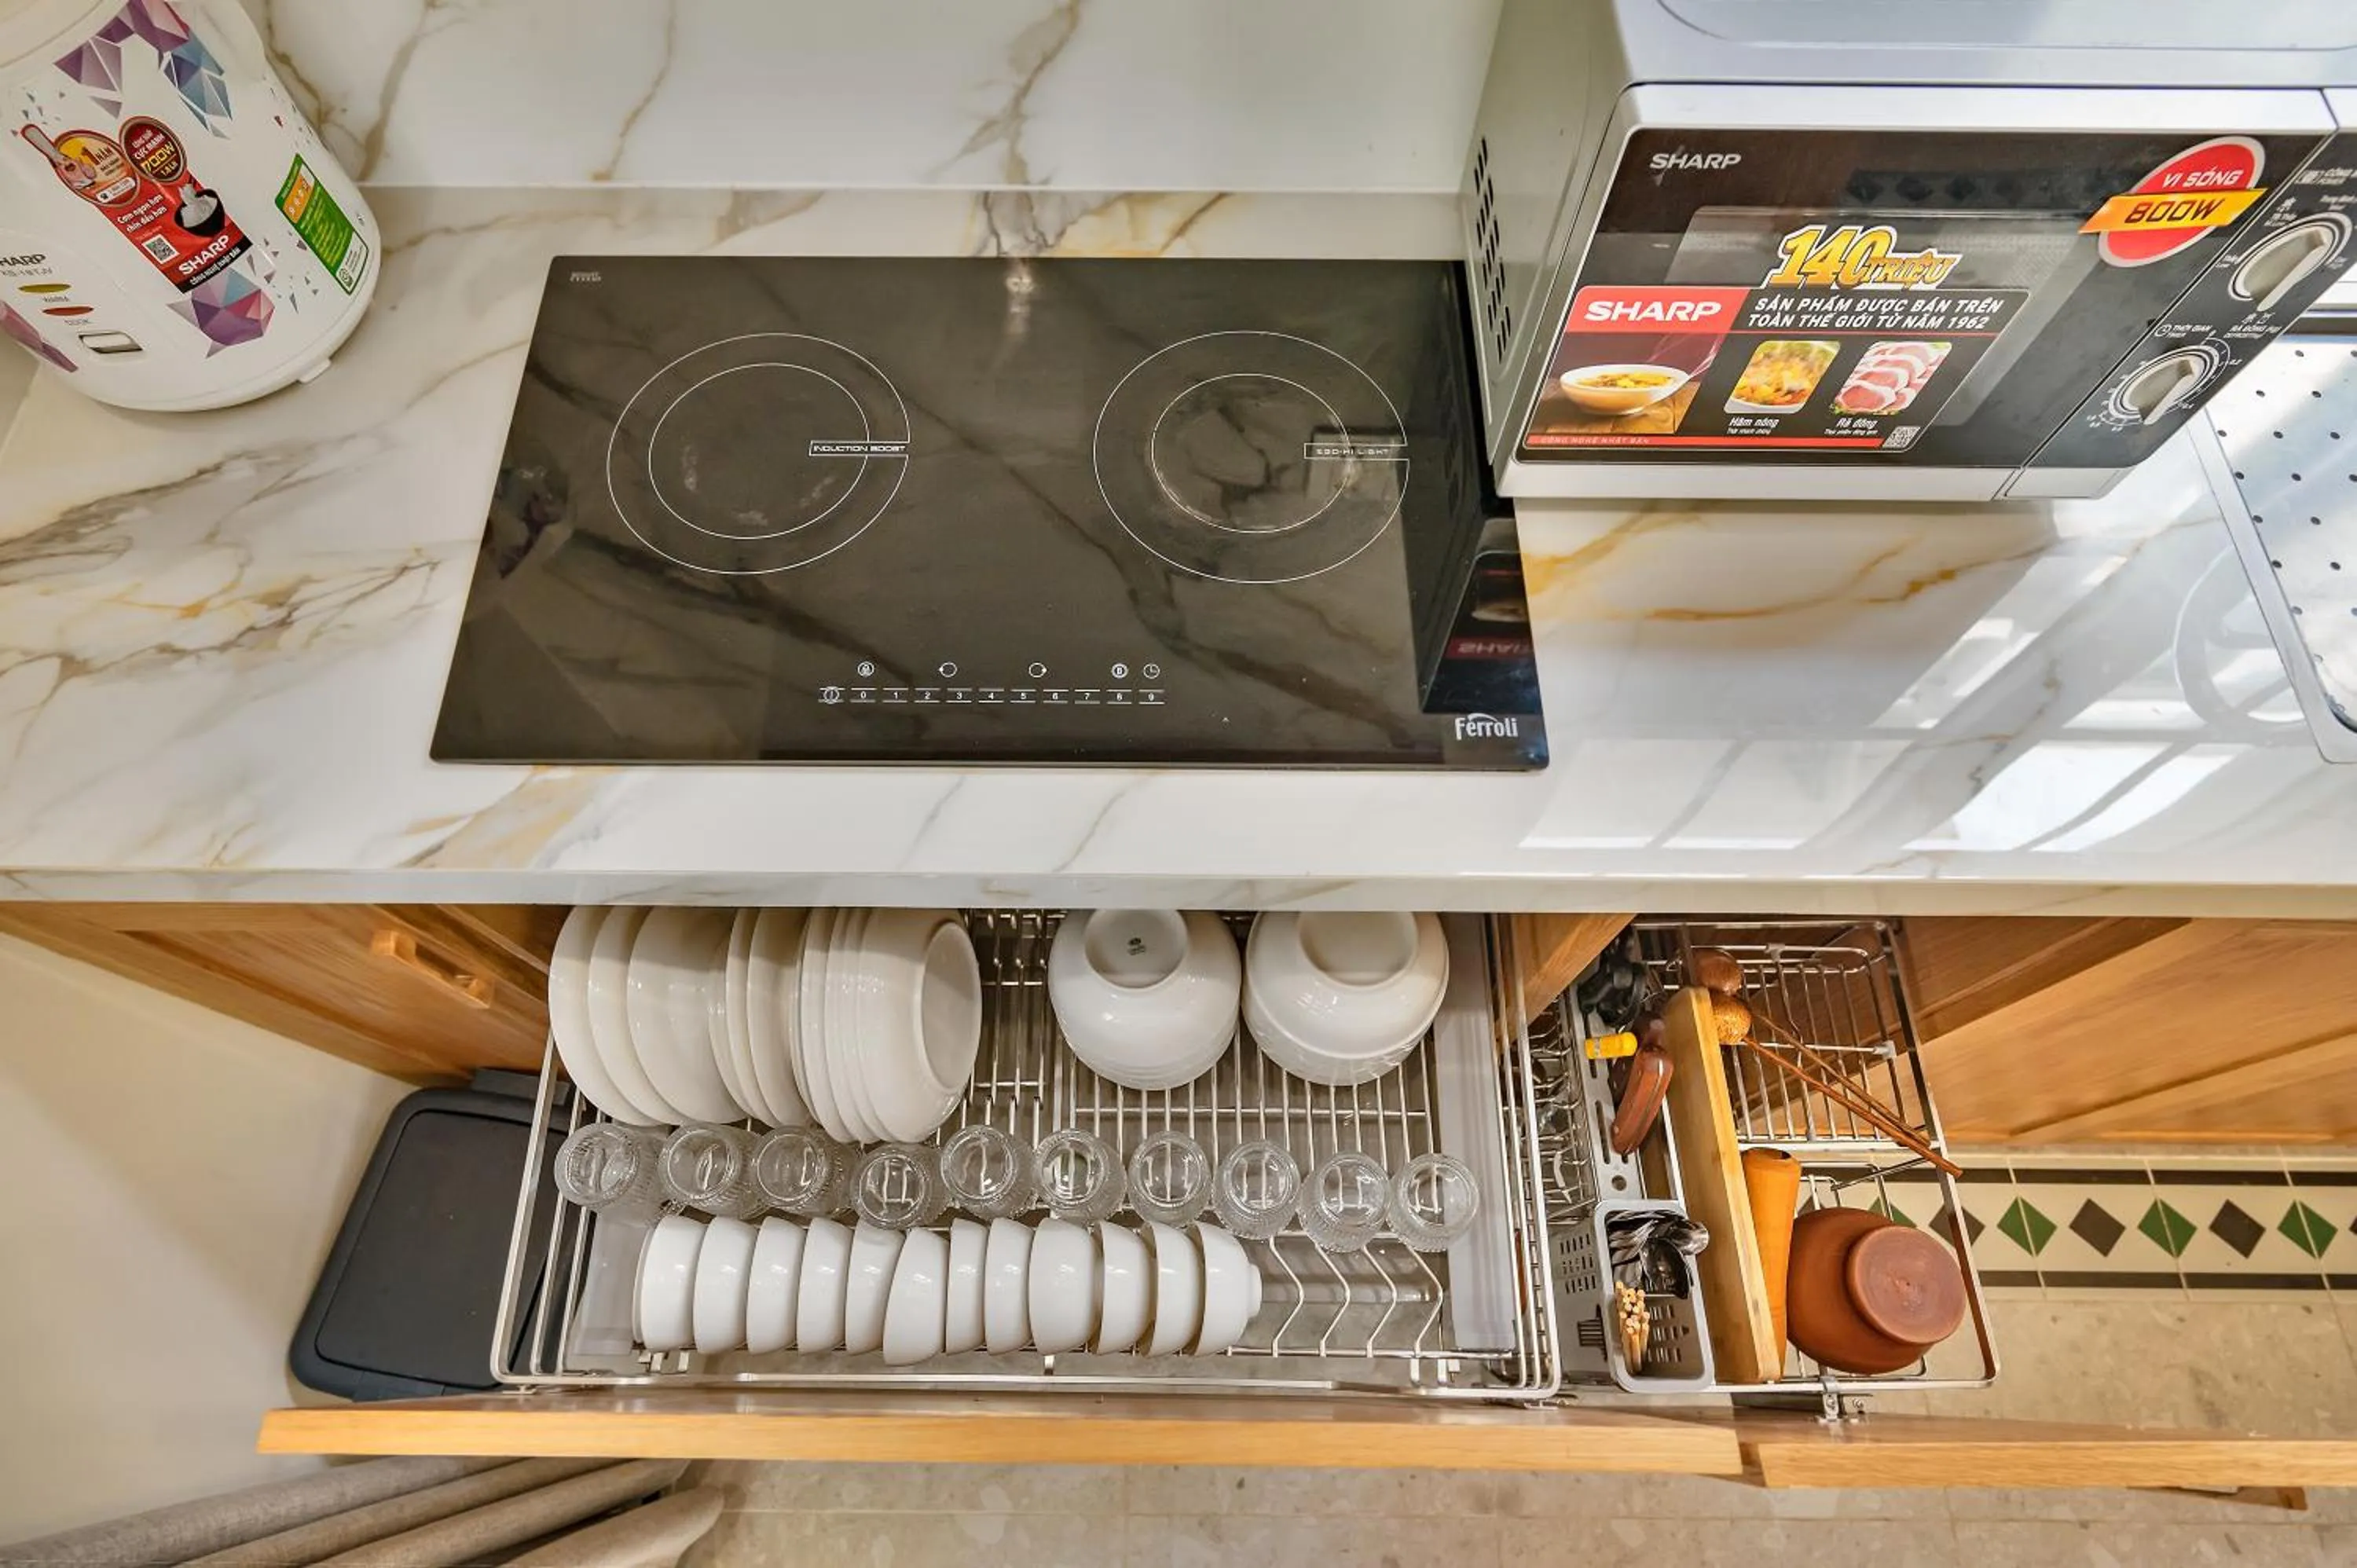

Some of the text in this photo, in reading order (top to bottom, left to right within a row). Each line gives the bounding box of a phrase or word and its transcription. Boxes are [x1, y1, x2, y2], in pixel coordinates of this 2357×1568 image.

[1649, 153, 1742, 170] SHARP
[2161, 166, 2244, 189] VI SÓNG
[2124, 198, 2226, 224] 800W
[0, 254, 46, 266] HARP
[178, 234, 230, 276] SHARP
[1766, 225, 1895, 289] 140
[1584, 301, 1722, 321] SHARP
[1911, 296, 1952, 313] BÁN
[1954, 296, 2005, 313] TRÊN
[1946, 315, 1990, 329] 1962
[1455, 713, 1518, 741] Ferroli
